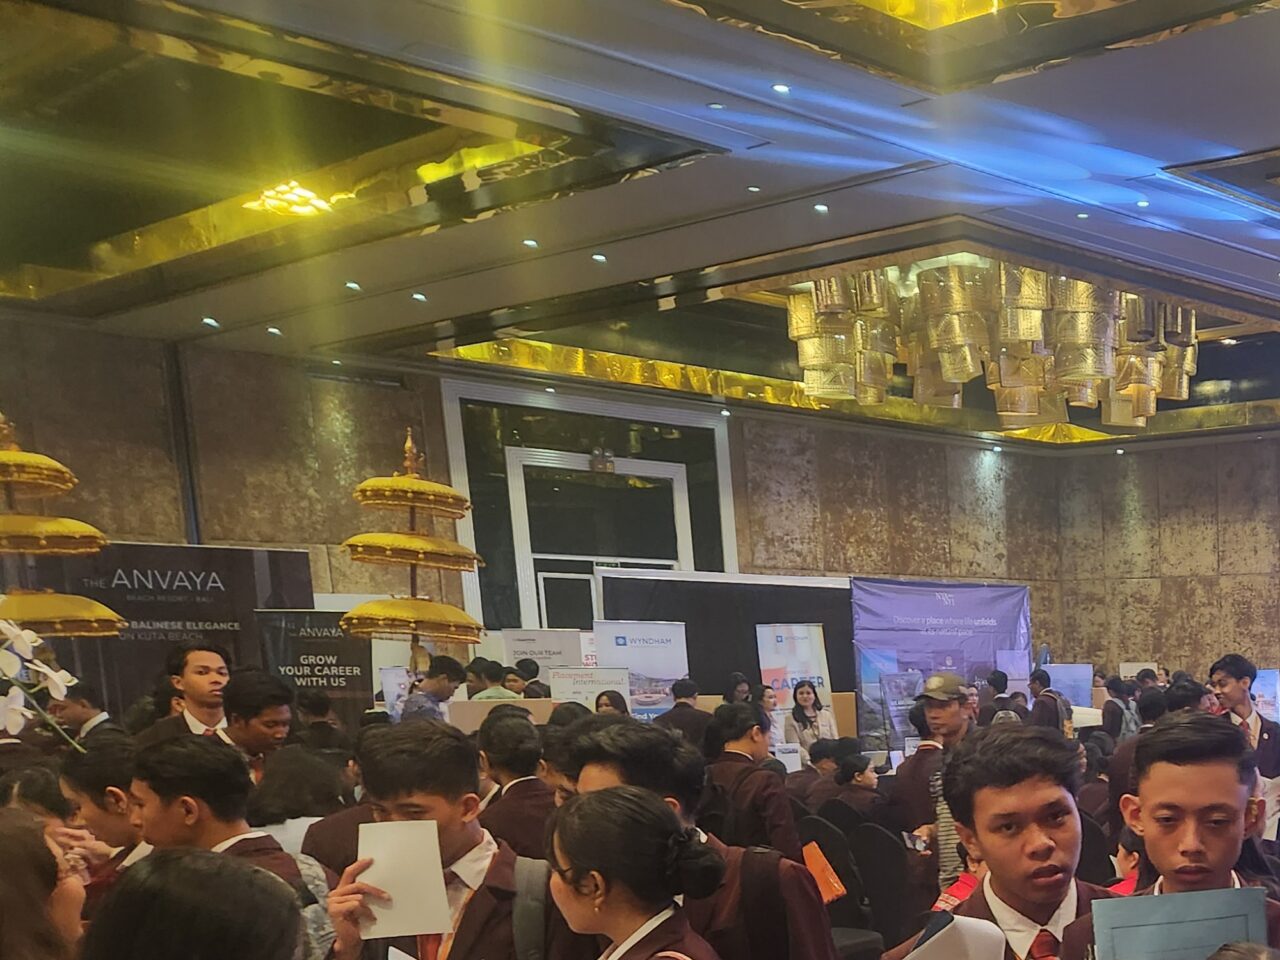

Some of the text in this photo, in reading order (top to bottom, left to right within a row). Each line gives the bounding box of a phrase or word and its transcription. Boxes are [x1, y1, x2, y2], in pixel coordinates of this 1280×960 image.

[82, 568, 225, 591] THE ANVAYA
[131, 620, 241, 631] BALINESE ELEGANCE
[119, 631, 203, 641] ON KUTA BEACH
[298, 627, 344, 637] ANVAYA
[629, 637, 671, 645] WYNDHAM
[299, 655, 337, 664] GROW
[278, 665, 361, 675] YOUR CAREER
[294, 677, 347, 686] WITH US
[771, 676, 825, 689] CARER
